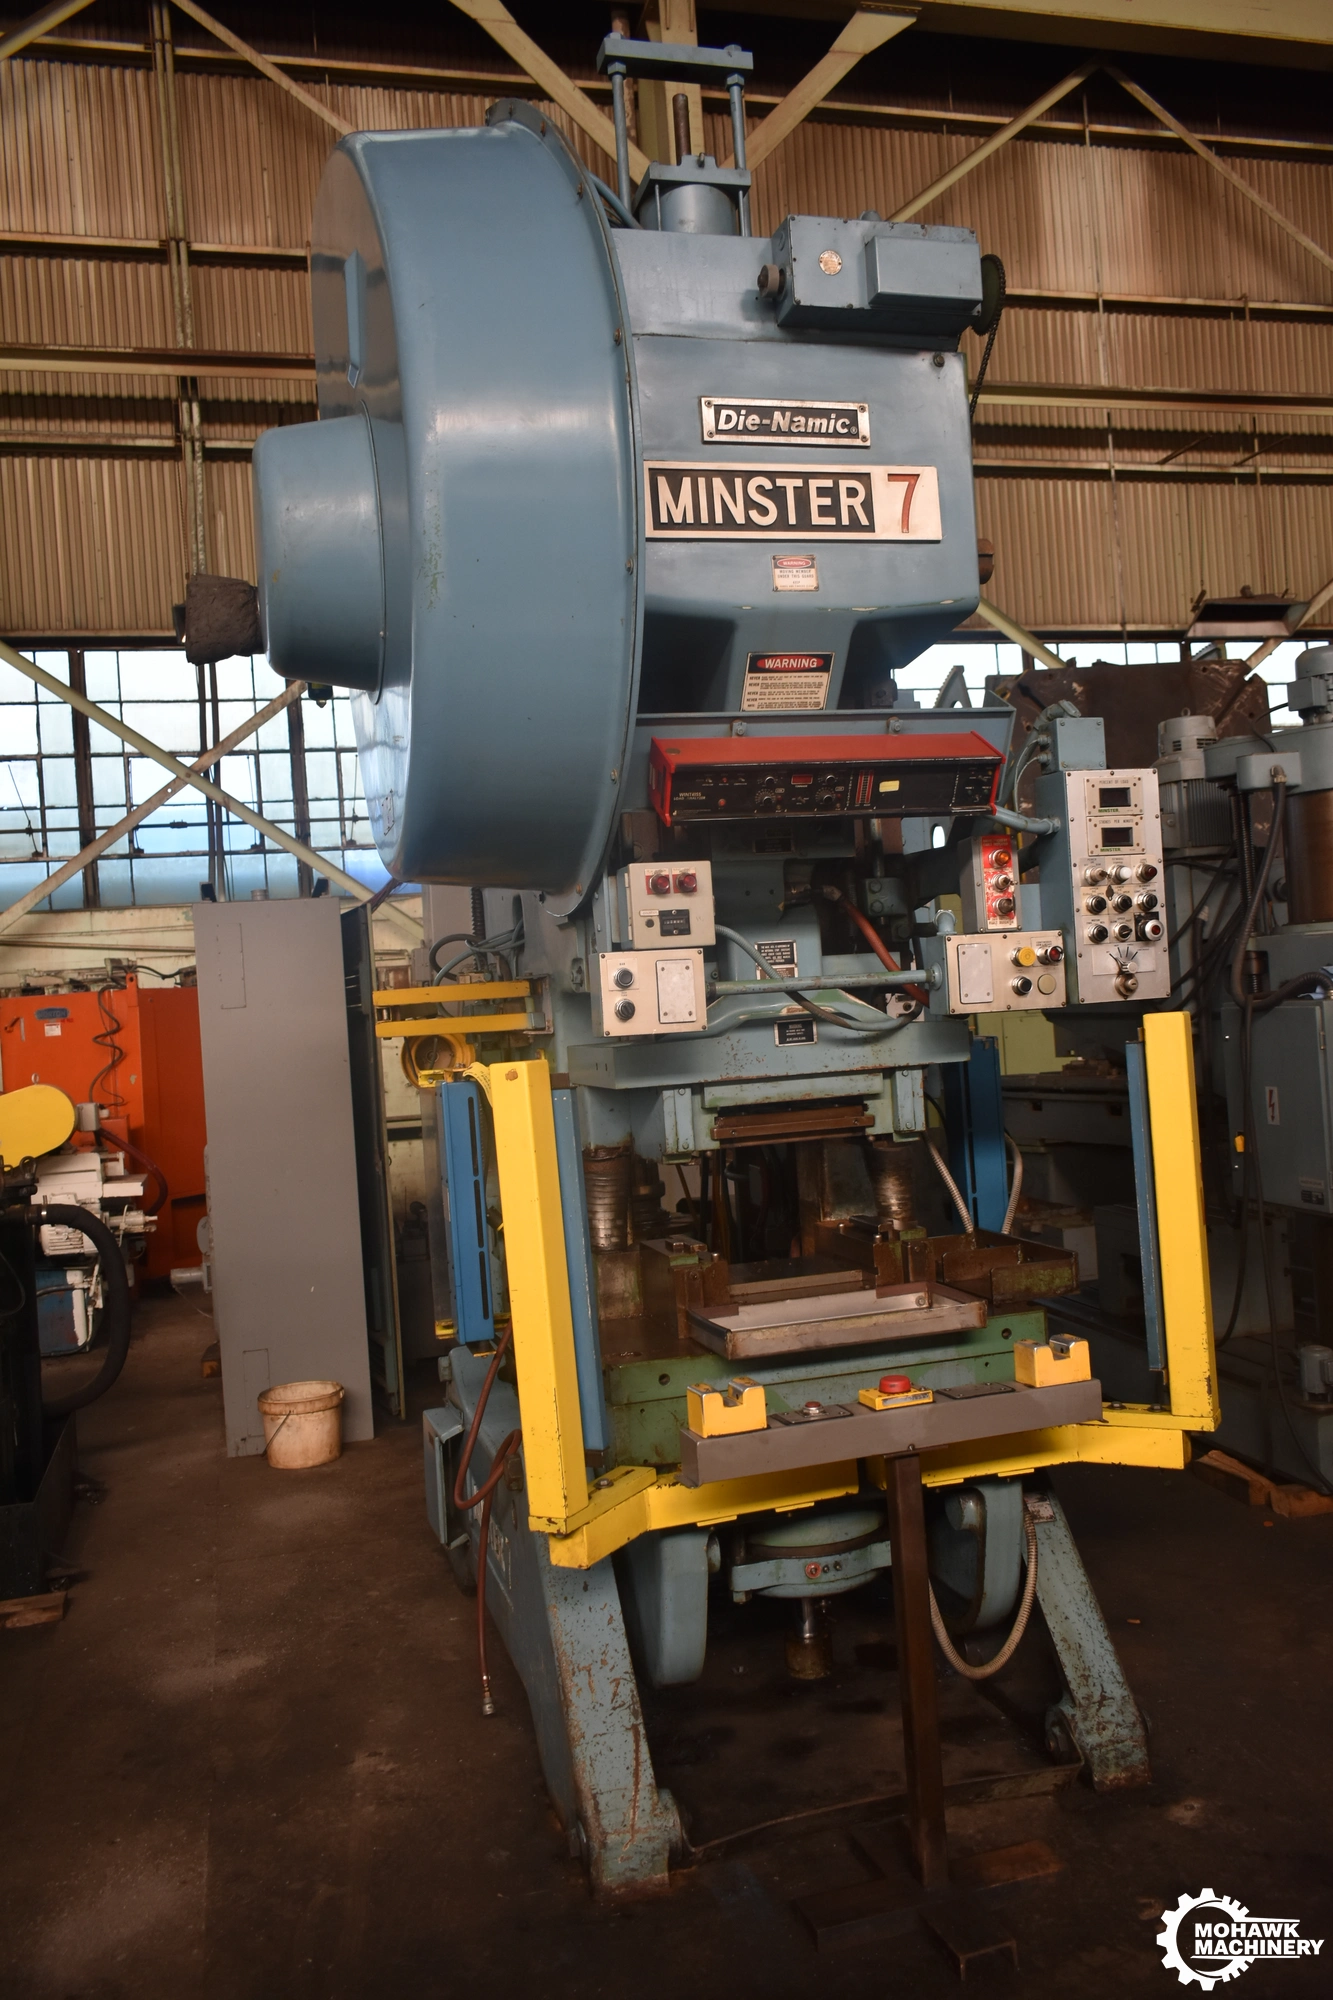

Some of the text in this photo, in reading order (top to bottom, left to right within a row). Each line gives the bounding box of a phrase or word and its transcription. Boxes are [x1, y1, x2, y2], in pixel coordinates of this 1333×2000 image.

[656, 473, 921, 534] MINSTER 7
[764, 658, 818, 669] WARNING
